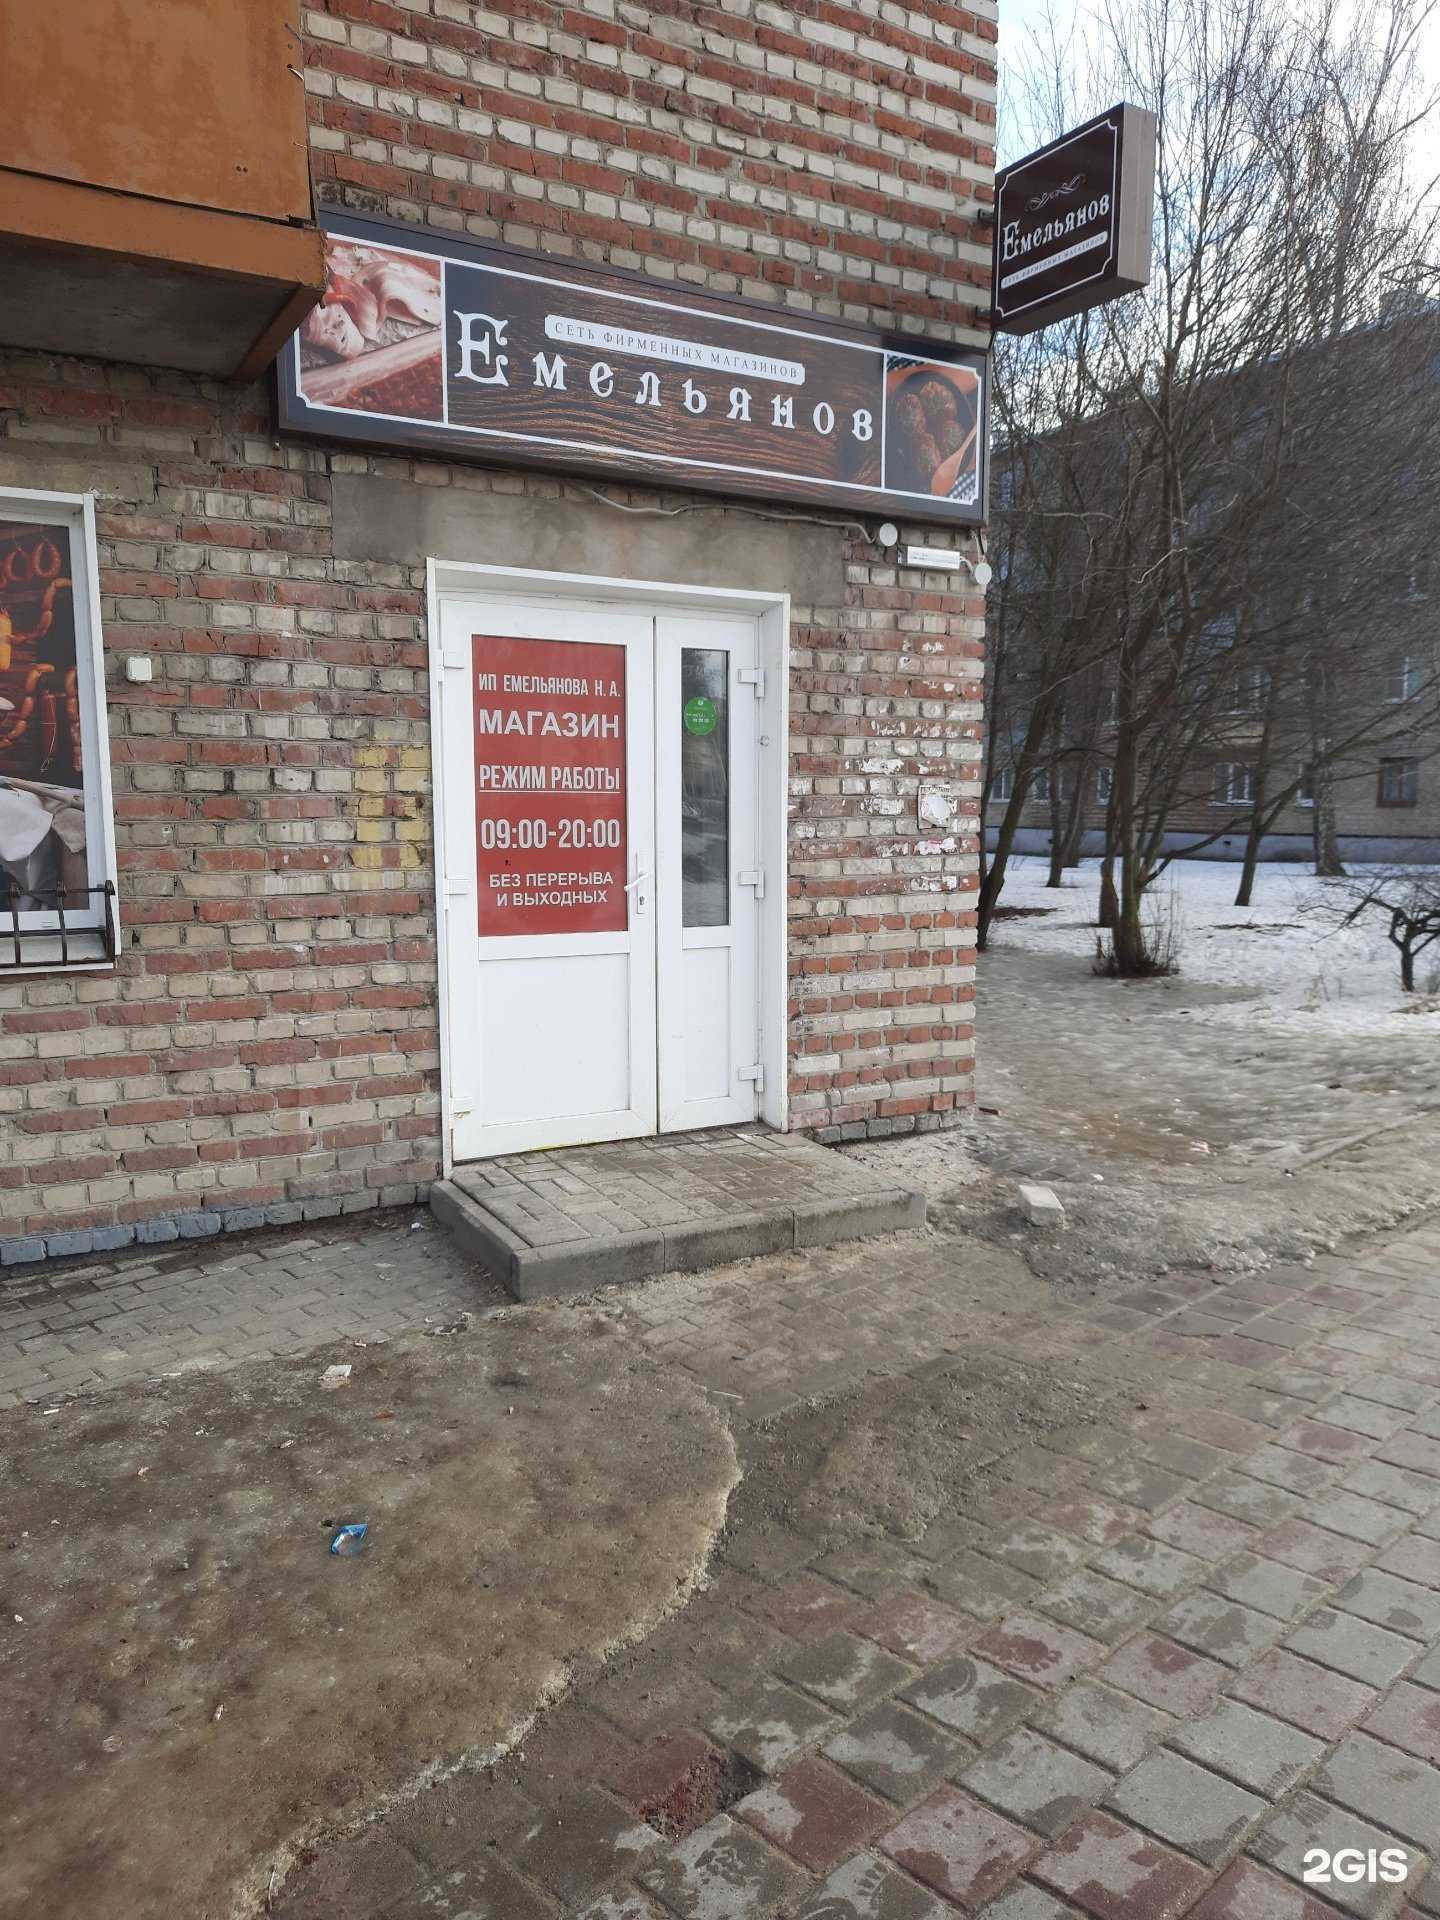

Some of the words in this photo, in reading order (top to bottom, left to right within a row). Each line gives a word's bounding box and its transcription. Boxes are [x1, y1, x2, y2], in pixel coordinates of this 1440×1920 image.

[1002, 194, 1110, 262] Емельянов
[555, 322, 595, 340] СЕТЬ
[603, 332, 703, 361] ФИРМЕННЫХ
[710, 352, 798, 379] МАГАЗИНОВ
[453, 310, 873, 441] Емельянов
[479, 673, 497, 691] ИП
[503, 675, 589, 696] ЕМЕЛЬЯНОВА
[480, 709, 619, 738] МАГАЗИН
[480, 764, 546, 789] РЕЖИМ
[551, 766, 620, 790] РАБОТЫ
[481, 818, 620, 849] 09:00-20:00
[489, 873, 521, 888] БЕЗ
[526, 871, 614, 887] ПЕРЕРЫВА
[497, 893, 508, 906] И
[512, 889, 608, 907] ВЫХОДНЫХ
